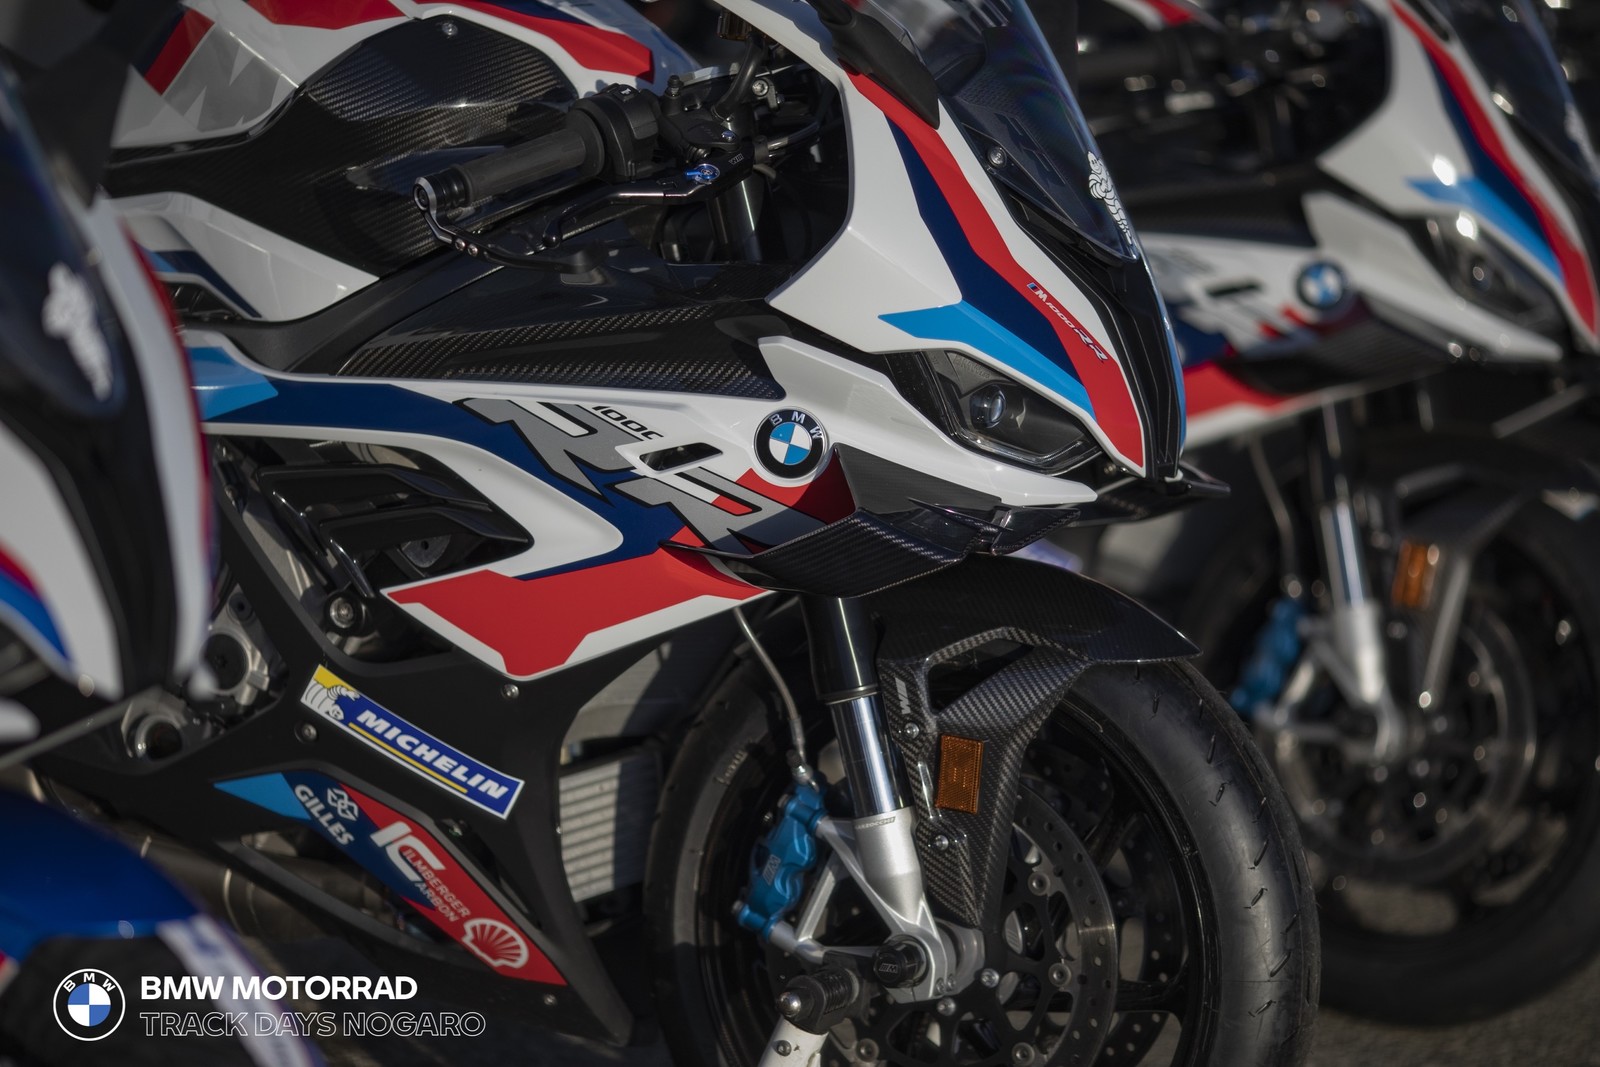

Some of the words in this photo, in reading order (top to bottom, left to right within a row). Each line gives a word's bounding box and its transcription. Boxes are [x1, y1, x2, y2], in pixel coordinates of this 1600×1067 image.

[769, 411, 823, 439] BMW
[356, 709, 509, 800] MICHELIN
[295, 785, 355, 846] GILLES
